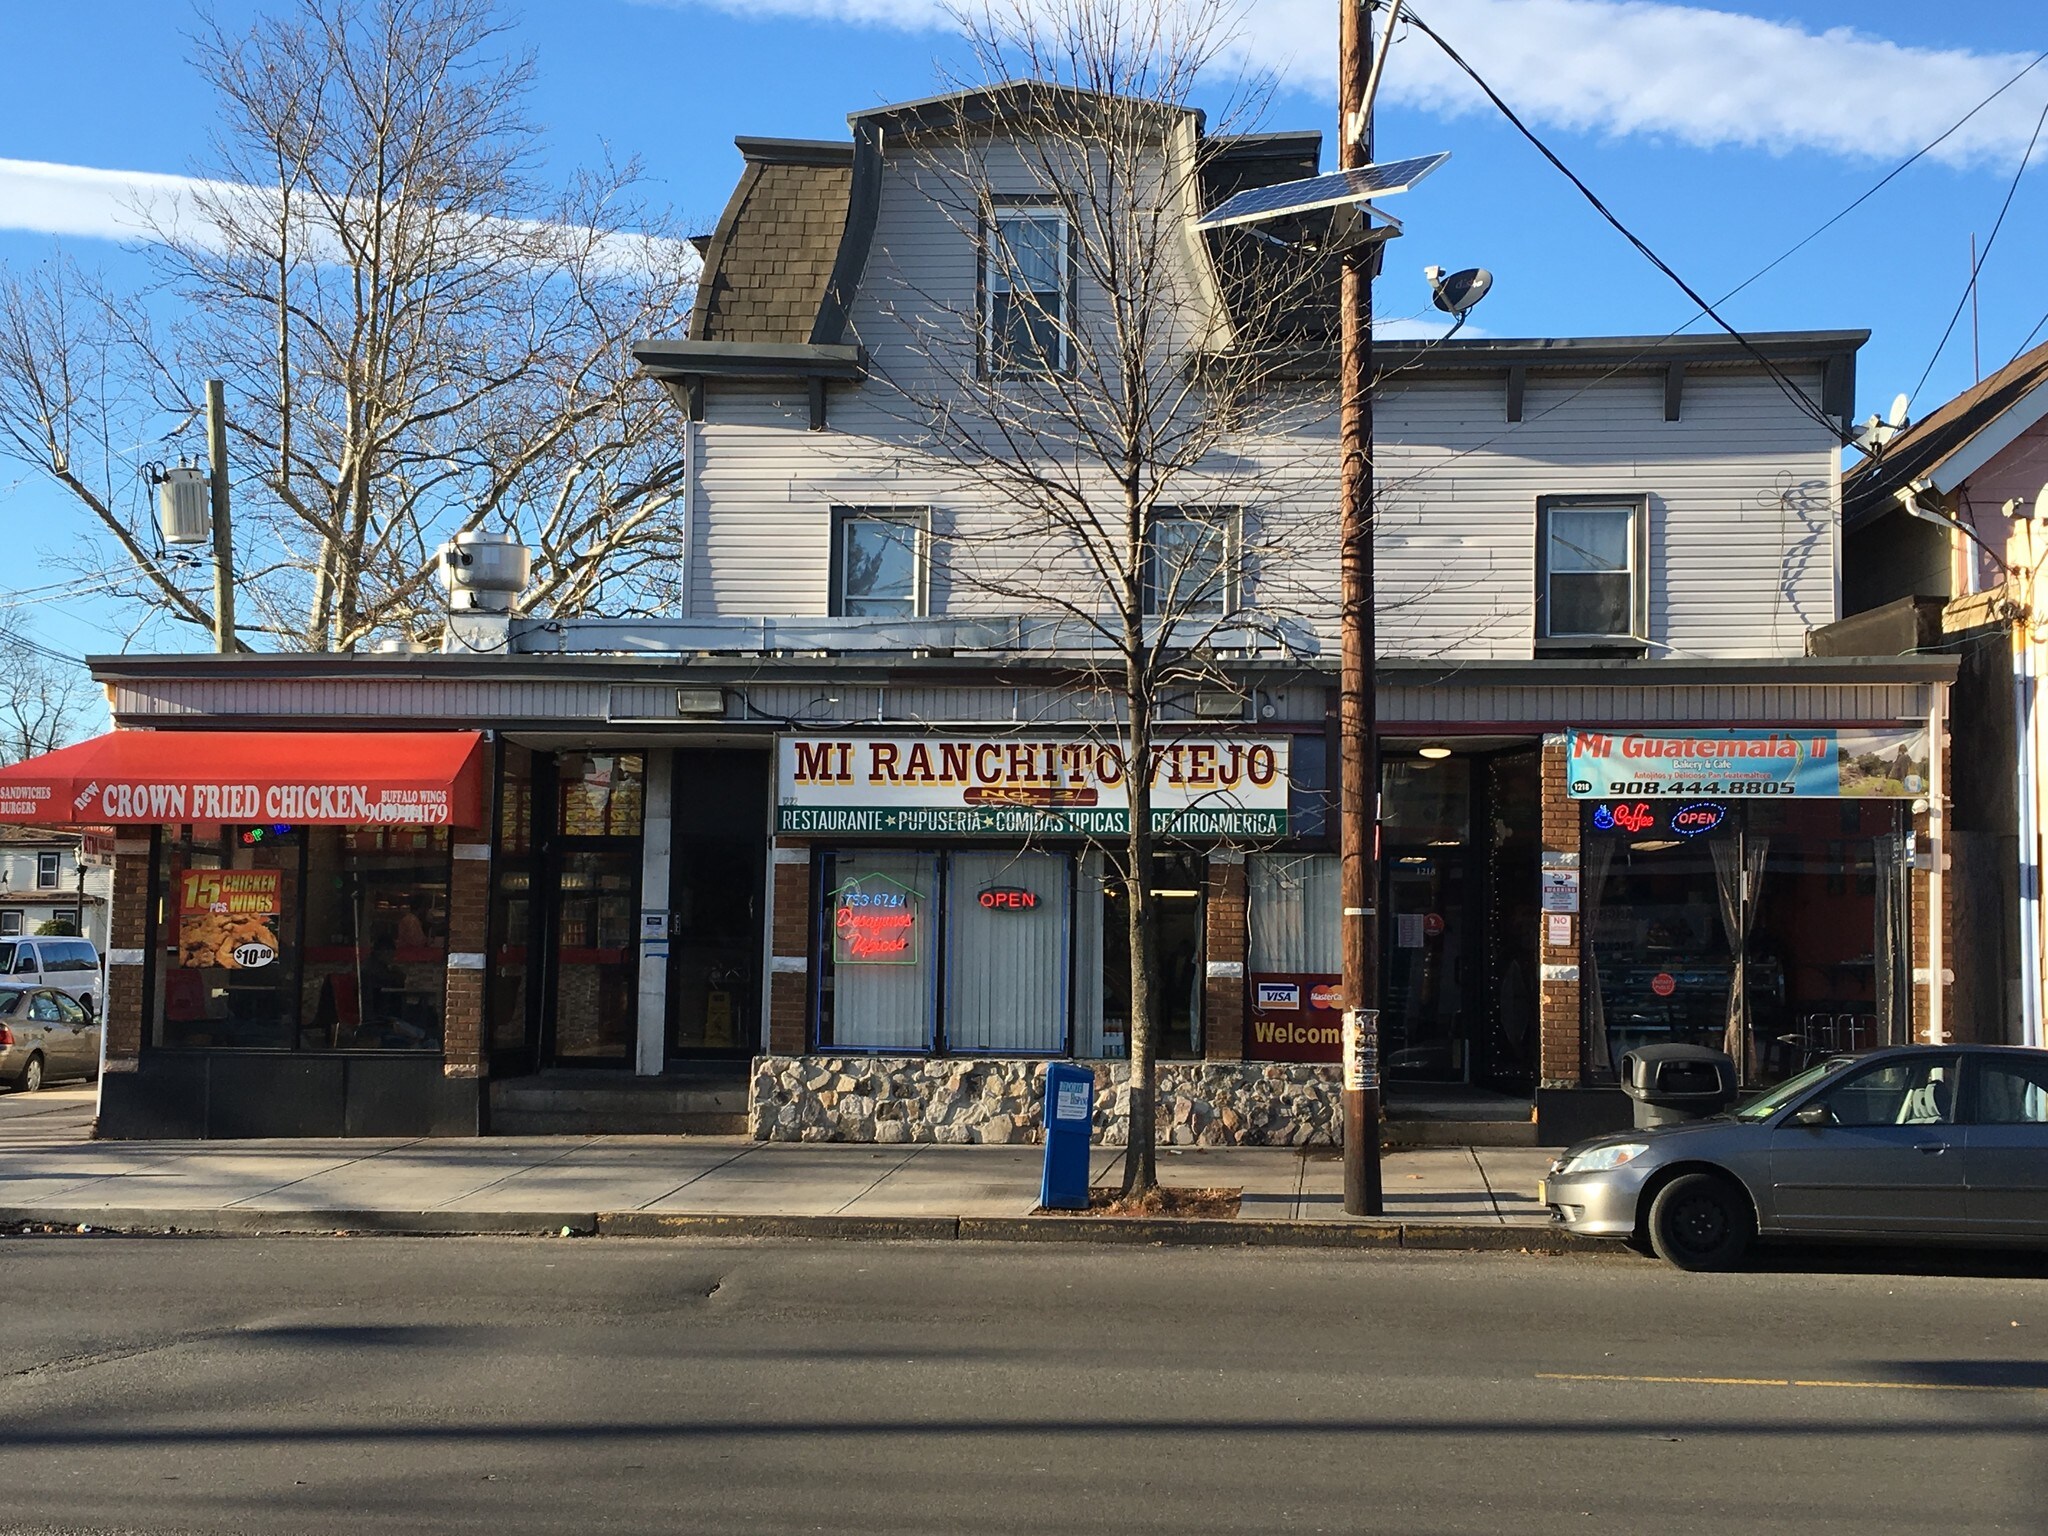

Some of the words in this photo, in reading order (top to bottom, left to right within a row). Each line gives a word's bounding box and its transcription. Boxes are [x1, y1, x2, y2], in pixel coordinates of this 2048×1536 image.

[1574, 732, 1613, 758] Mi
[1622, 734, 1797, 758] Guatemala
[794, 742, 855, 786] MI
[868, 742, 1125, 788] RANCHITO
[1149, 744, 1278, 789] VIEJO
[1673, 760, 1702, 770] Bakery
[1705, 760, 1711, 769] &
[1634, 772, 1666, 781] Antojitos
[0, 787, 51, 799] SANDWICHES
[981, 789, 1040, 798] No.
[1574, 783, 1590, 792] 1218
[1609, 782, 1795, 795] 908.444.8805
[74, 781, 100, 811] new
[102, 784, 187, 818] CROWN
[191, 784, 260, 818] FRIED
[265, 785, 368, 818] CHICKEN
[381, 790, 418, 803] BUFFALO
[420, 791, 447, 803] WINGS
[0, 802, 36, 814] BURGERS
[782, 810, 884, 831] RESTAURANTE
[898, 810, 981, 831] PUPUSERIA
[996, 811, 1064, 833] COMIDAS
[1068, 812, 1124, 833] TIPICAS
[1152, 812, 1277, 834] CENTROAMERICA
[1613, 803, 1655, 832] Coffee
[1678, 812, 1717, 824] OPEN
[184, 874, 221, 910] 15
[222, 875, 277, 892] CHICKEN
[209, 902, 229, 913] PCS.
[229, 894, 274, 912] WINGS
[980, 892, 1034, 907] OPEN
[236, 949, 272, 965] $10.00
[1266, 991, 1292, 1002] VISA
[1310, 992, 1343, 1001] MasterCa
[1255, 1022, 1342, 1044] Welcom
